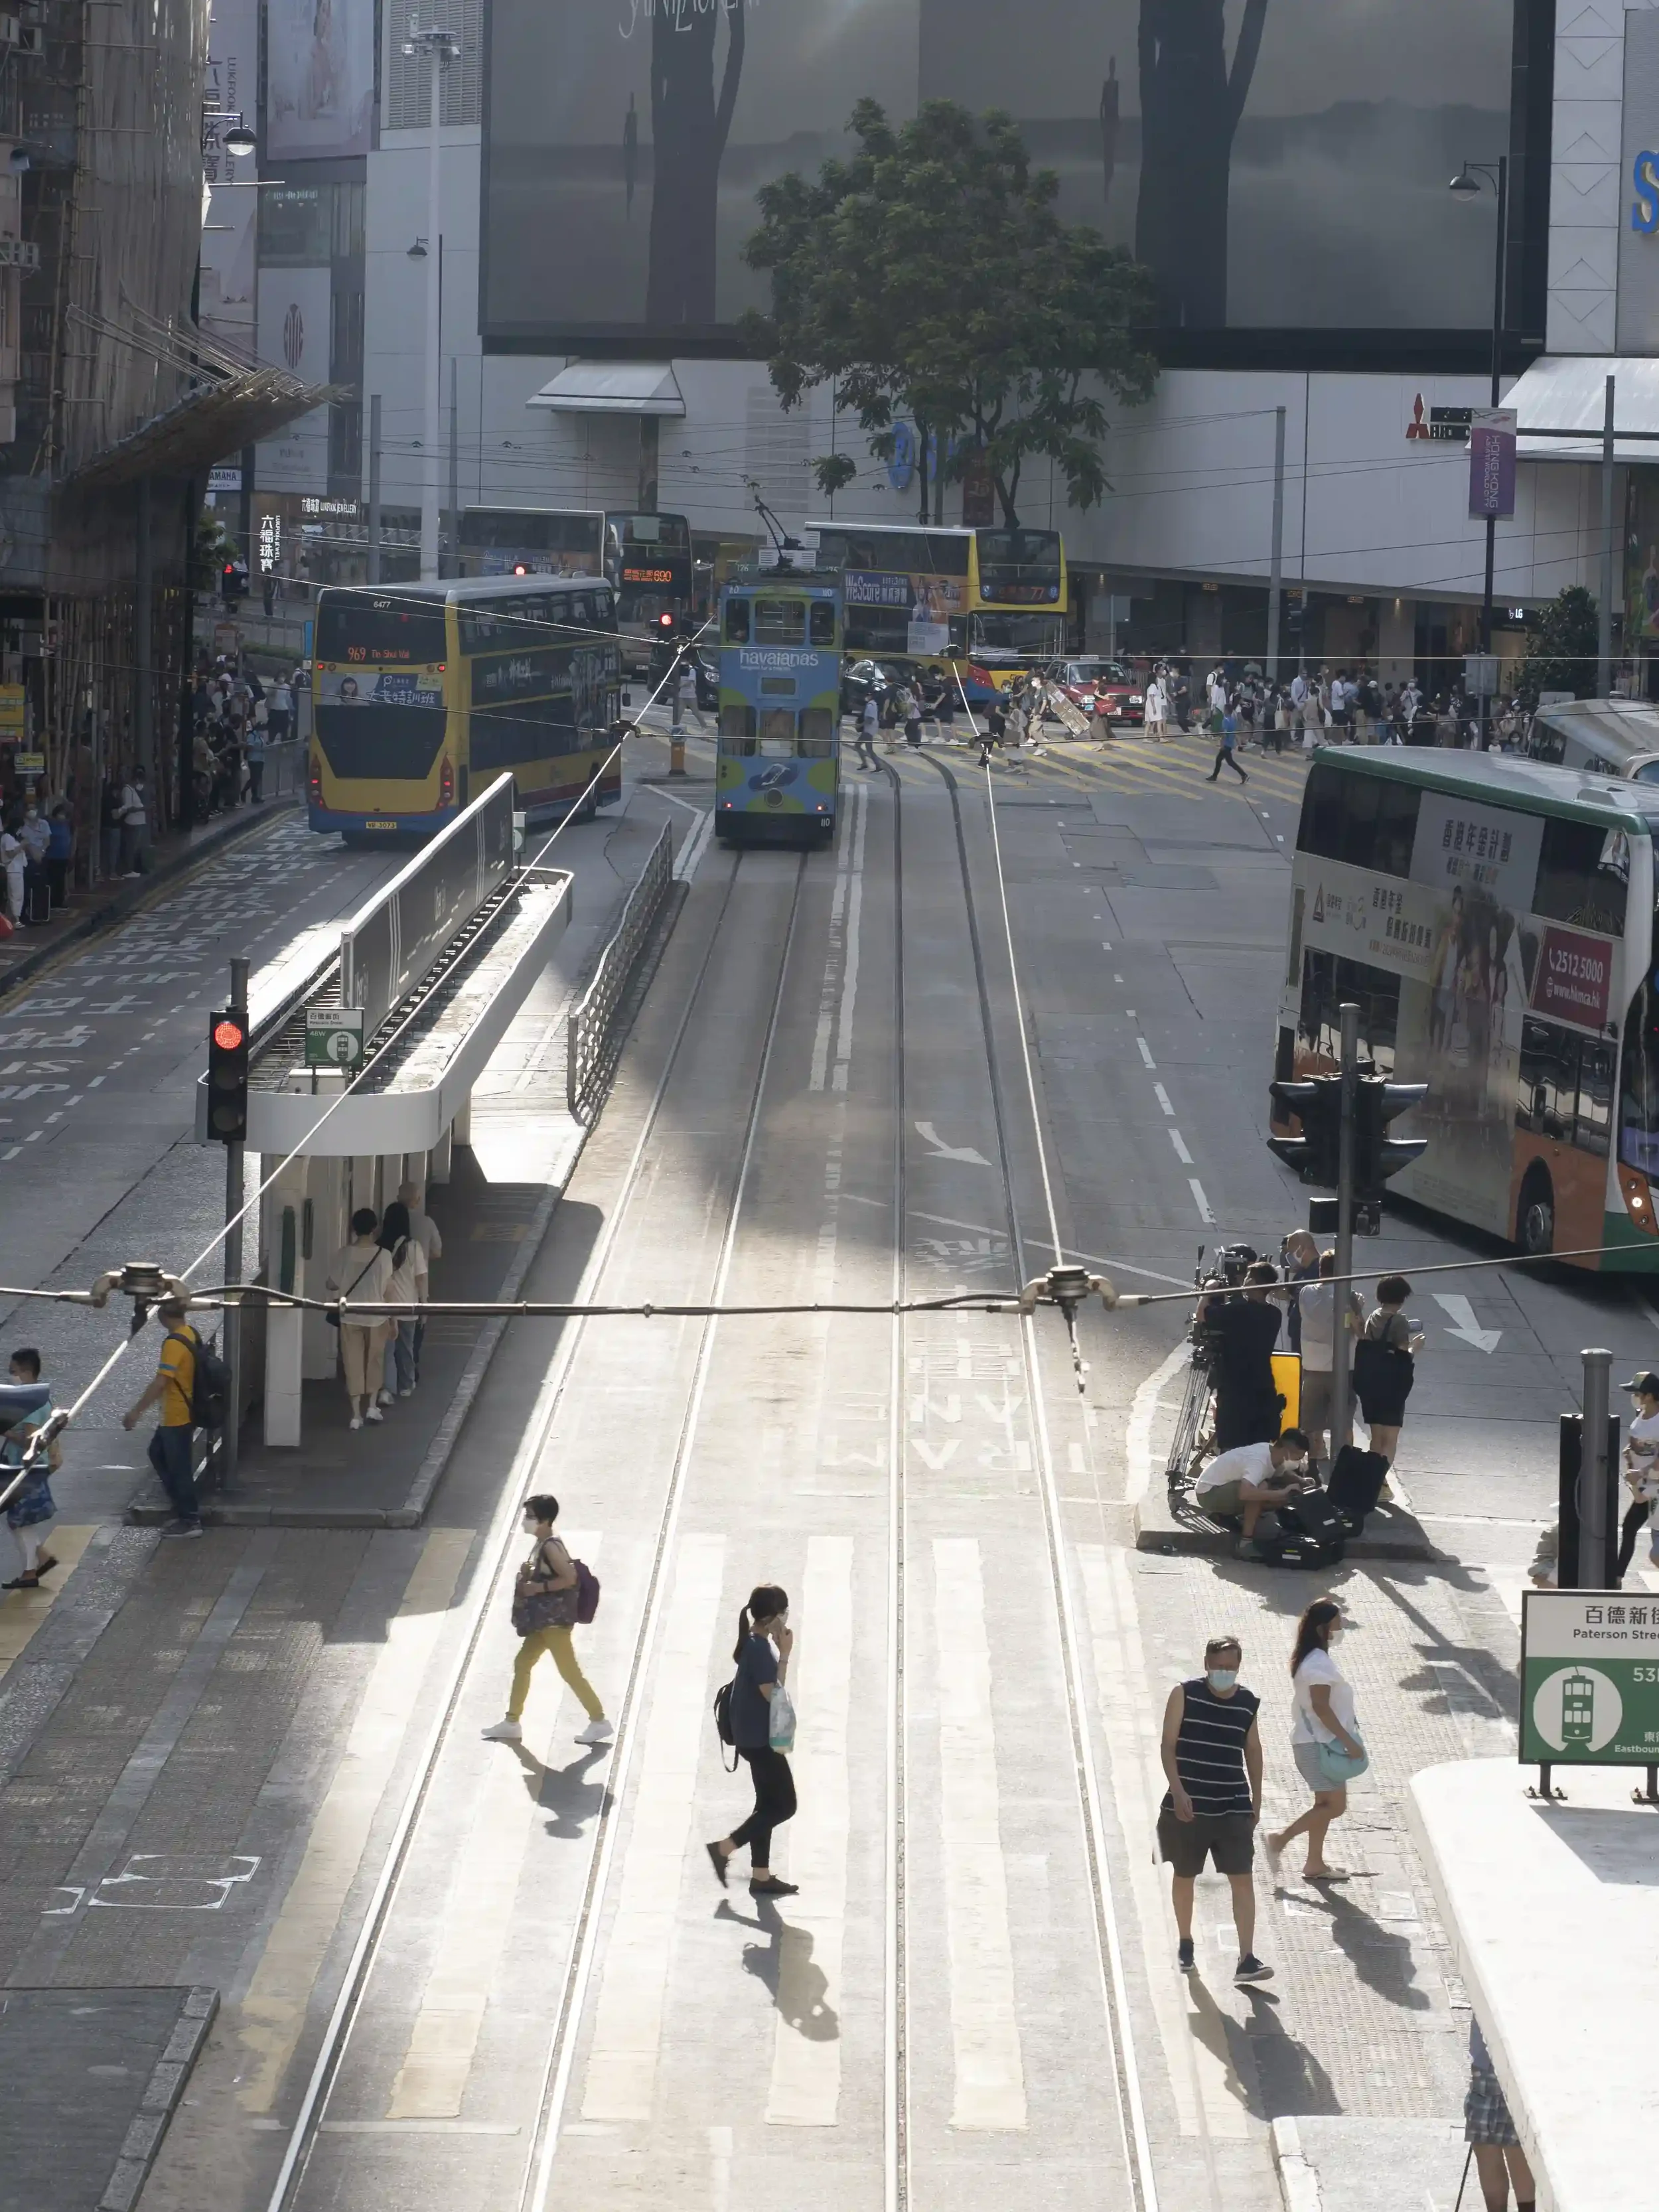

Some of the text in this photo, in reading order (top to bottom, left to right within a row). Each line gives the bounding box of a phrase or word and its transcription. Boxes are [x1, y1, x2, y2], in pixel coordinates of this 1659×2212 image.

[209, 471, 237, 481] AMAHA
[1489, 435, 1500, 508] HONG KONG
[259, 514, 275, 572] 六福珠寶
[845, 575, 881, 602] WeScore
[1515, 608, 1523, 619] LG
[347, 646, 367, 662] 969
[739, 648, 819, 668] havaianas
[821, 818, 831, 827] 110
[68, 952, 210, 967] BUS
[1555, 949, 1603, 984] 2512 5000
[29, 972, 202, 989] STOP
[1, 994, 153, 1018] 巴士
[1573, 1629, 1628, 1639] Paterson
[1633, 1667, 1659, 1683] 53
[1615, 1745, 1659, 1754] Eastboun
